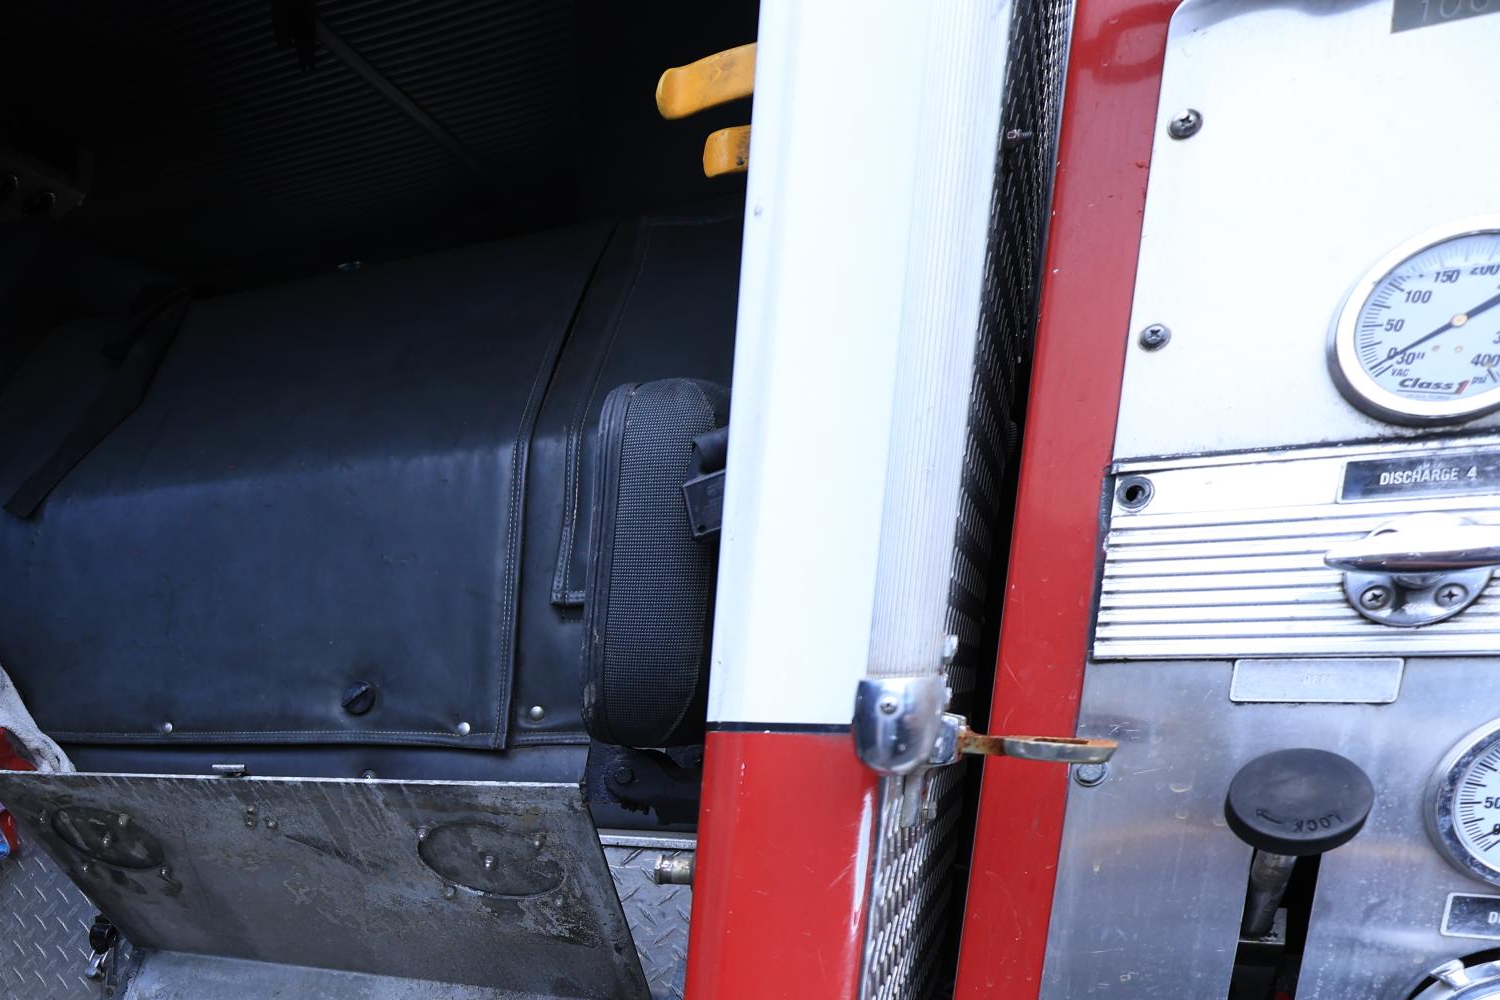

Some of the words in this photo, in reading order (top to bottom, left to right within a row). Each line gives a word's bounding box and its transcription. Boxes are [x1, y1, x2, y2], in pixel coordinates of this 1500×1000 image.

[1434, 269, 1461, 283] 150
[1405, 290, 1432, 304] 100
[1384, 319, 1405, 332] 50
[1391, 368, 1410, 377] VAC
[1379, 467, 1459, 486] DISCHARGE
[1466, 465, 1478, 480] 4
[1292, 811, 1344, 833] LOCK
